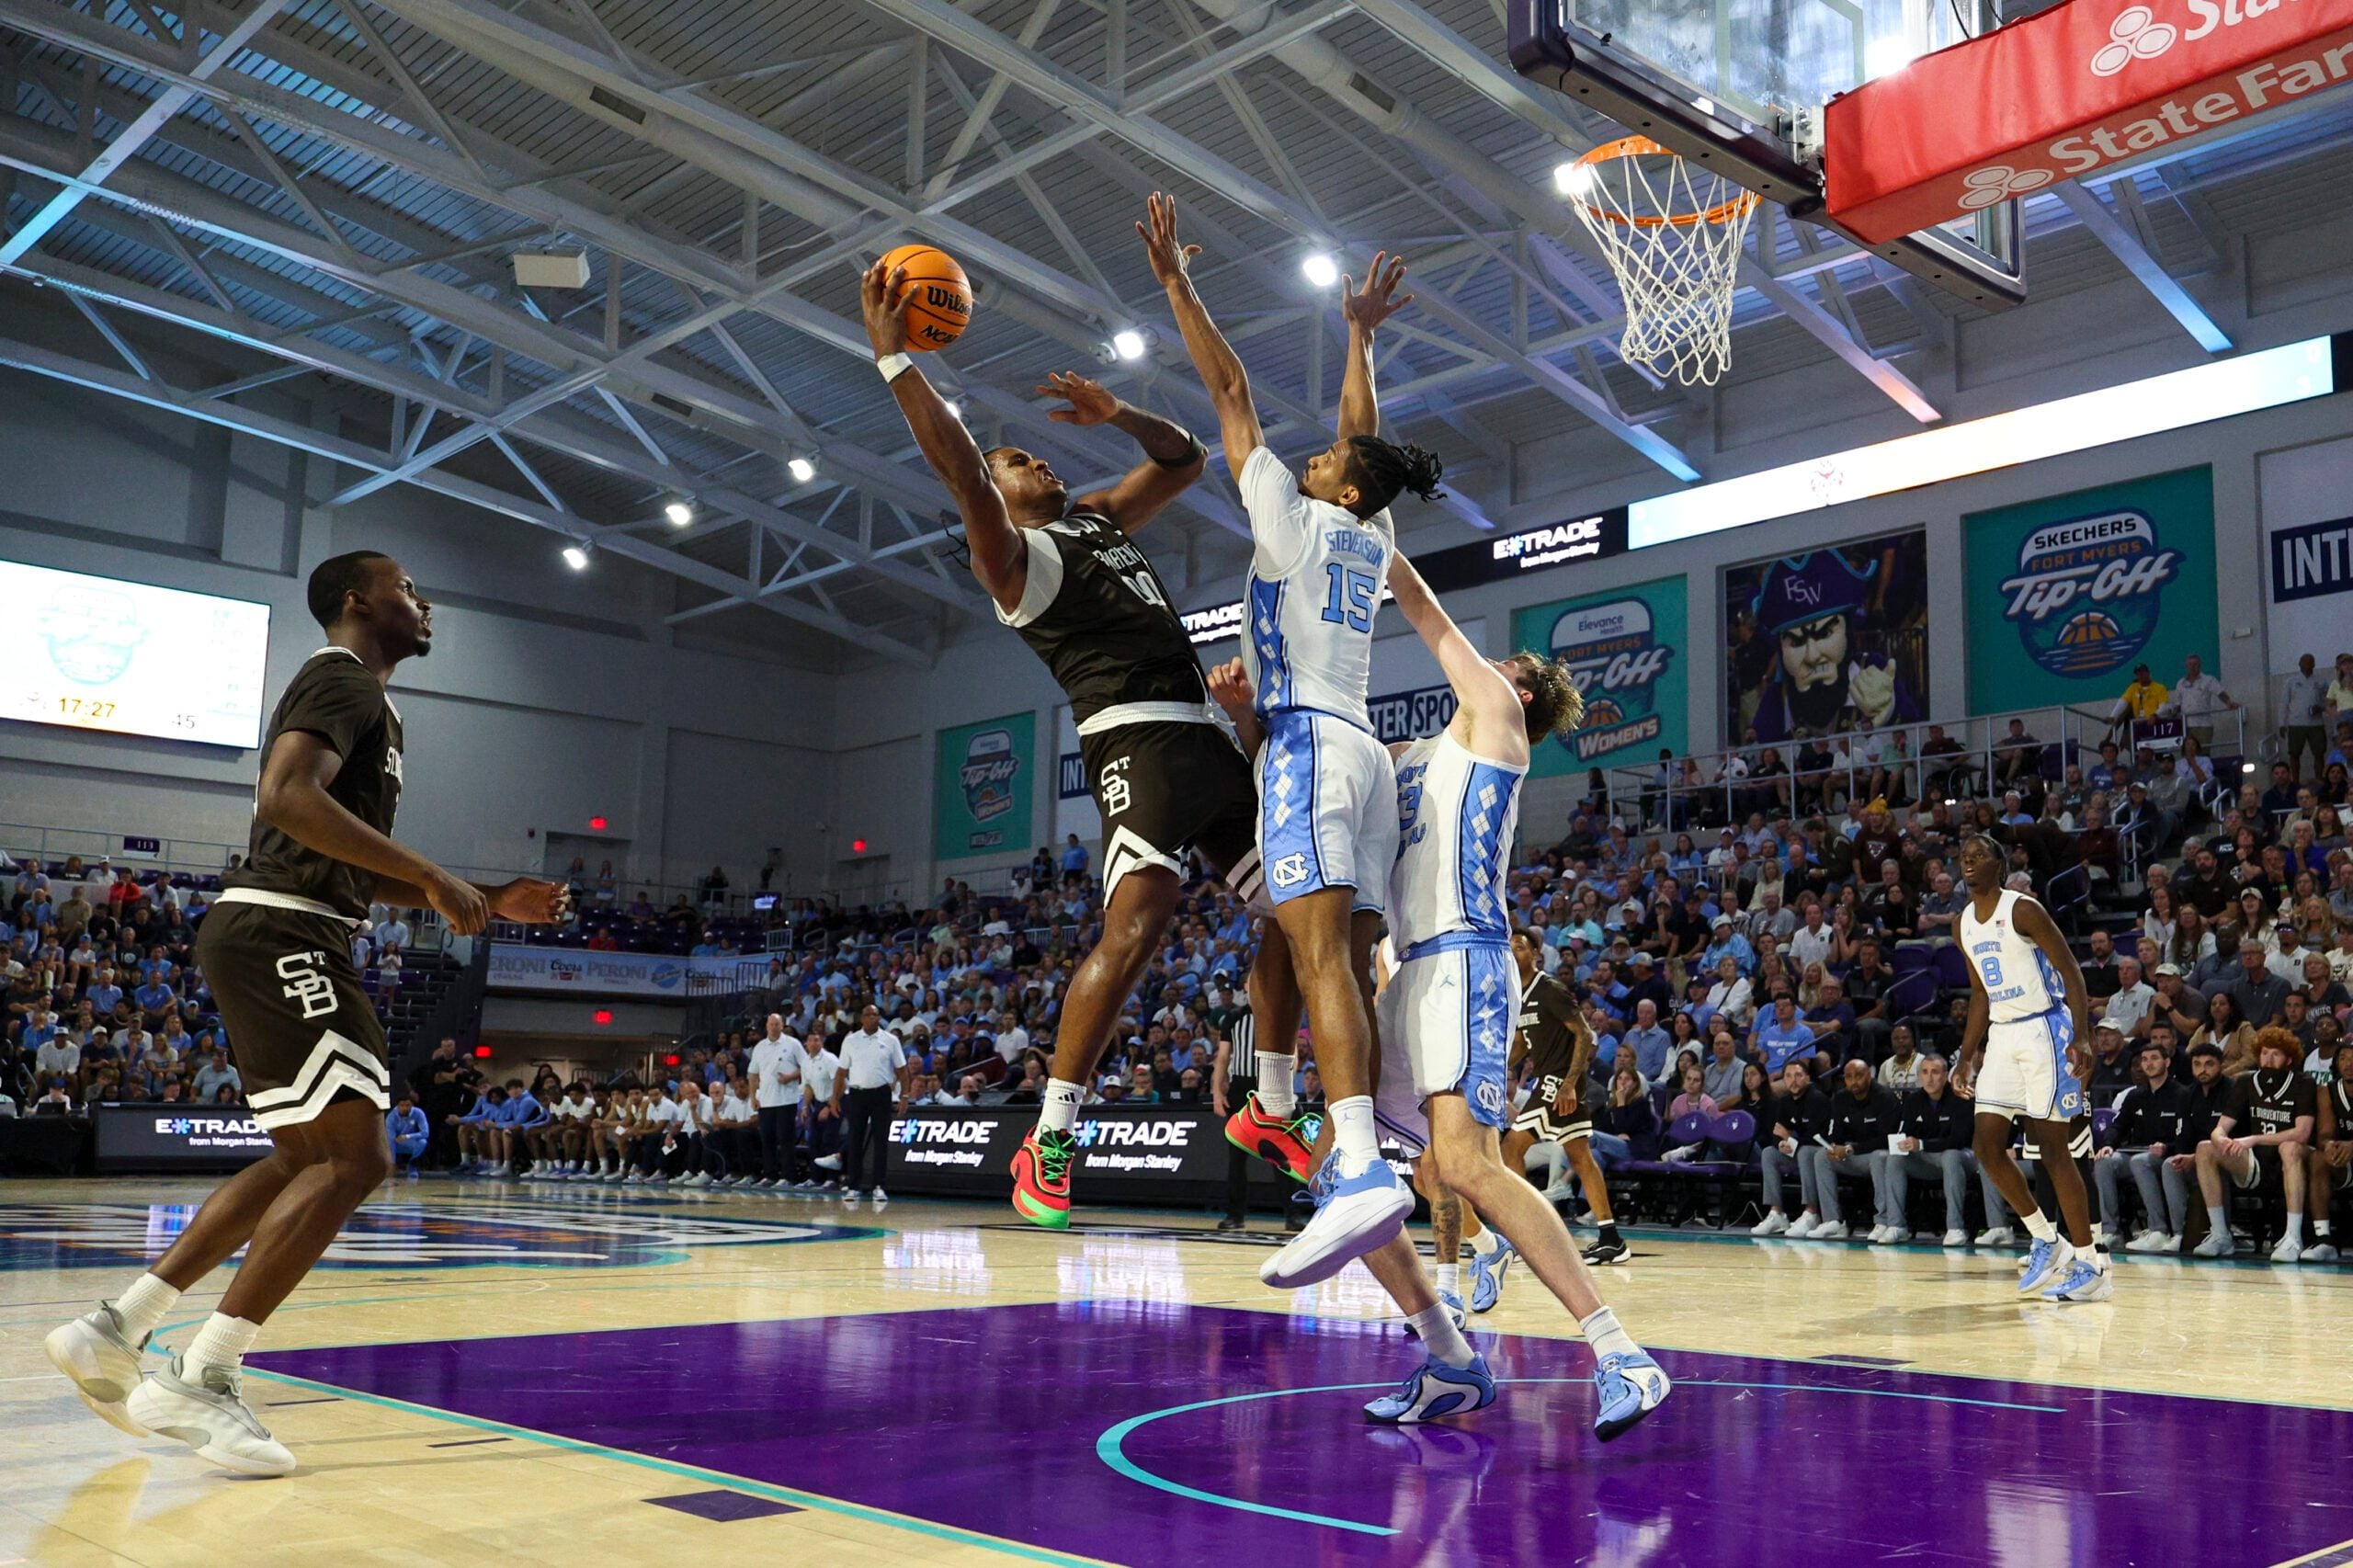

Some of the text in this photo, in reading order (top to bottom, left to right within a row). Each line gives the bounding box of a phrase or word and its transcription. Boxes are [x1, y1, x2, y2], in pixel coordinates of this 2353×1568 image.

[2034, 517, 2137, 550] SKECHERS
[1324, 529, 1385, 569] STEVENSON
[2031, 540, 2142, 572] FORT MYERS
[1784, 575, 1822, 606] FSW
[2002, 552, 2175, 620] Tip-Off
[1321, 562, 1376, 633] 15
[1578, 615, 1624, 632] Elevance
[1600, 626, 1624, 636] Health
[1597, 637, 1641, 654] MYERS
[59, 698, 116, 718] 17:27
[2154, 722, 2174, 736] 117
[1981, 956, 2004, 987] 8
[188, 1137, 211, 1147] from
[212, 1137, 245, 1148] Morgan
[904, 1149, 983, 1167] from Morgan Stanley
[1086, 1153, 1182, 1172] from Morgan Stanley
